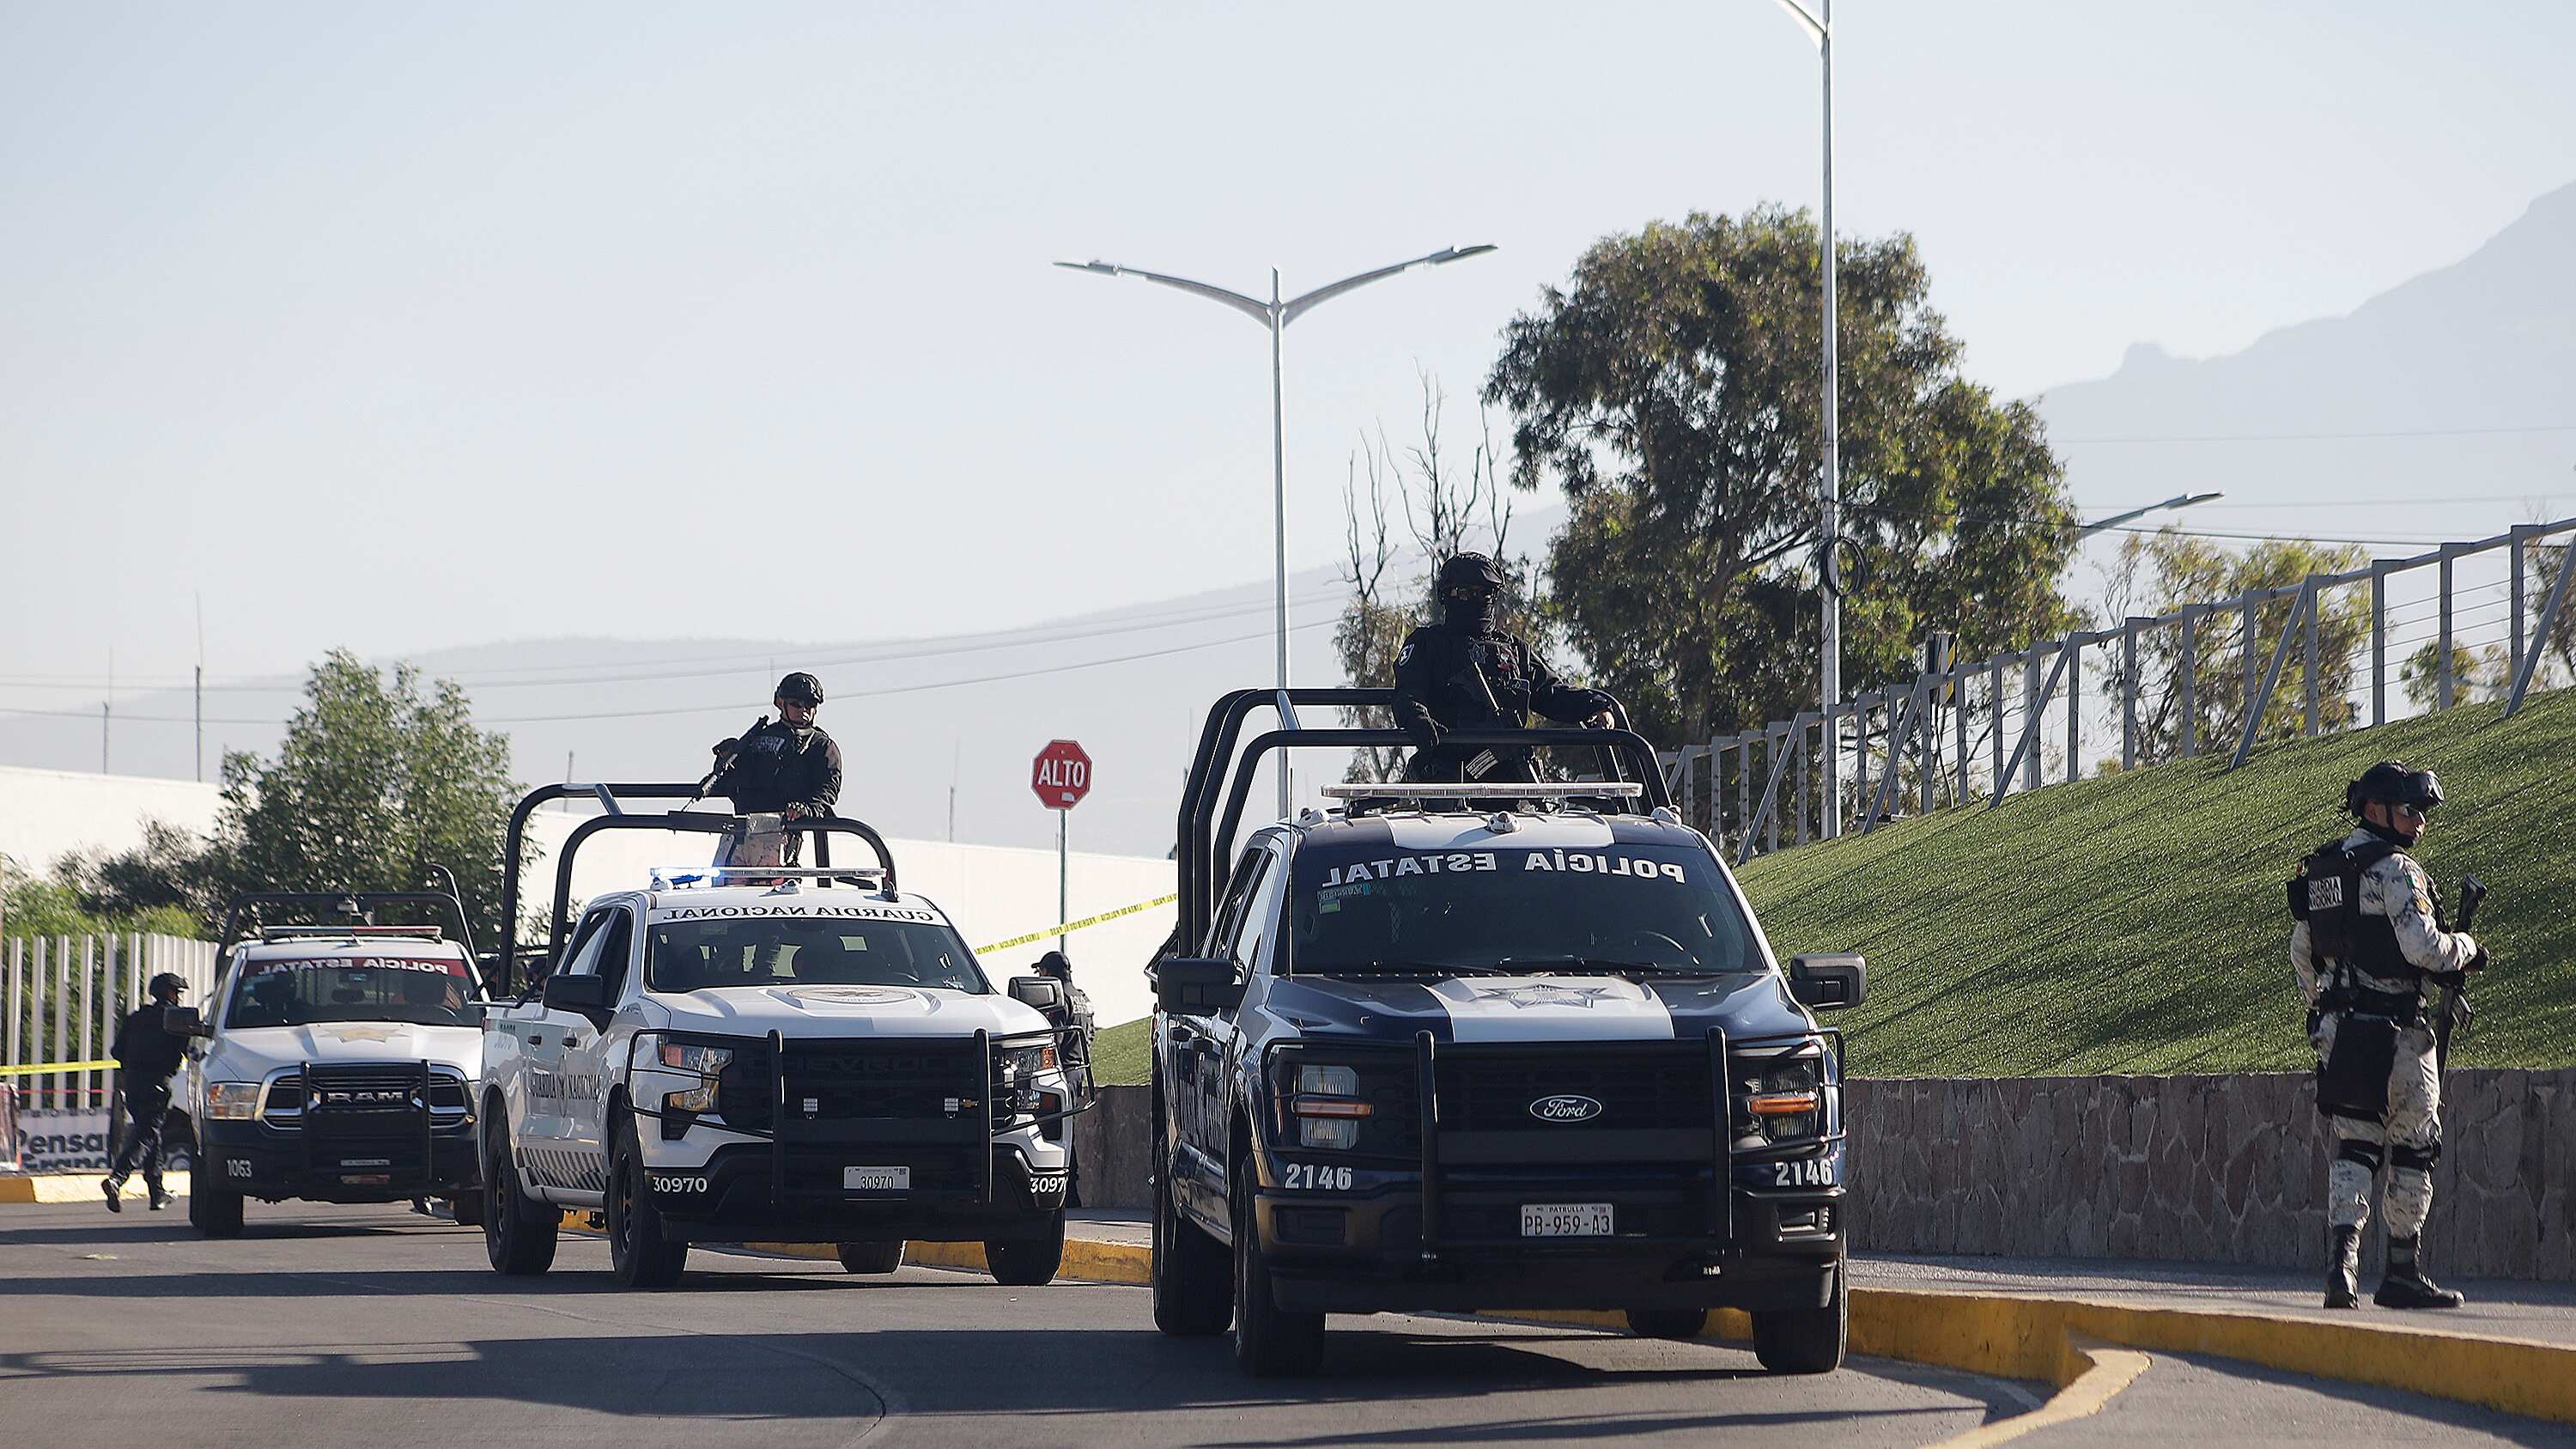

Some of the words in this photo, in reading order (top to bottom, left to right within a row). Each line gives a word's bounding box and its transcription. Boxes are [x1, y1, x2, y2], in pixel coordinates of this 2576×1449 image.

[1037, 758, 1085, 788] ALTO
[327, 1092, 403, 1103] RAM
[1544, 1099, 1588, 1117] Ford
[17, 1129, 110, 1153] Pensa
[227, 1160, 252, 1177] 1063
[1285, 1163, 1352, 1190] 2146
[1775, 1159, 1833, 1186] 2146
[653, 1177, 708, 1193] 30970
[860, 1176, 894, 1189] 30970
[1030, 1177, 1067, 1194] 3097
[1524, 1215, 1610, 1235] PB-959-A3
